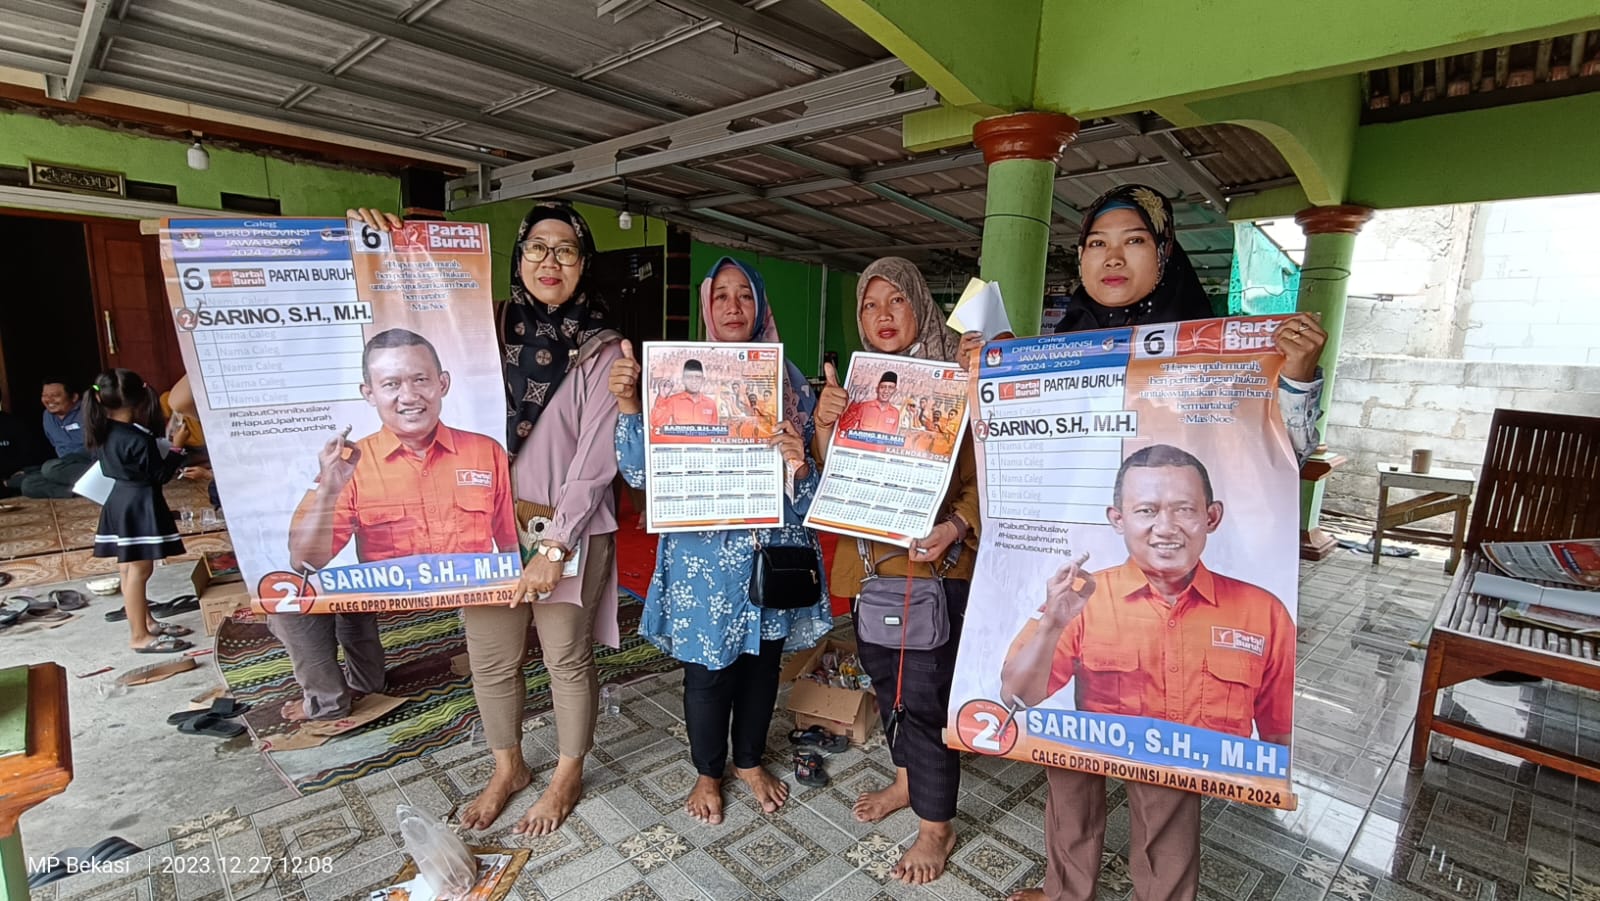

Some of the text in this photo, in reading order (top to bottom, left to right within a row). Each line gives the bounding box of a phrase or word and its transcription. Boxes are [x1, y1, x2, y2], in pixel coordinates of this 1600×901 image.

[243, 220, 278, 229] Caleg
[428, 224, 480, 236] Partai
[213, 229, 311, 237] DPRD PROVINSI
[361, 224, 382, 249] 6
[225, 238, 303, 247] JAWA BARAT
[430, 236, 481, 249] Buruh
[183, 267, 205, 291] 6
[232, 270, 264, 278] Partai
[268, 266, 355, 282] PARTAI BURUH
[233, 277, 266, 285] Buruh
[198, 303, 372, 326] SARINO, S.H., M.H.
[182, 314, 194, 328] 2
[216, 331, 247, 340] Nama
[250, 328, 278, 339] Caleg
[1038, 336, 1066, 344] Caleg
[1041, 340, 1093, 351] PROVINSI
[1143, 329, 1166, 355] 6
[219, 347, 250, 356] Nama
[253, 345, 281, 355] Caleg
[738, 352, 745, 361] 6
[1018, 350, 1085, 362] JAWA BARAT
[223, 363, 253, 372] Nama
[255, 361, 284, 371] Caleg
[1020, 363, 1046, 371] 2024
[1053, 360, 1081, 368] 2029
[1199, 361, 1224, 373] upah
[934, 370, 941, 378] 6
[1234, 374, 1267, 384] hukum
[226, 379, 257, 389] Nama
[259, 376, 287, 387] Caleg
[1015, 381, 1040, 390] Partai
[1044, 373, 1125, 393] PARTAI BURUH
[230, 395, 260, 404] Nama
[262, 392, 289, 403] Caleg
[980, 382, 995, 404] 6
[1015, 388, 1040, 397] Buruh
[1219, 388, 1245, 398] kaum
[988, 414, 1136, 437] SARINO, S.H., M.H.
[1000, 442, 1022, 451] Nama
[1022, 440, 1044, 451] Caleg
[886, 447, 949, 462] KALENDAR 2024
[1000, 458, 1023, 467] Nama
[1023, 457, 1044, 467] Caleg
[1001, 473, 1023, 482] Nama
[1023, 473, 1043, 484] Caleg
[1000, 489, 1022, 499] Nama
[1023, 490, 1041, 502] Caleg
[1000, 506, 1022, 516] Nama
[1022, 507, 1041, 518] Caleg
[323, 556, 521, 591] SARINO, S.H., M.H.
[271, 581, 301, 613] 2
[328, 600, 359, 612] CALEG
[361, 599, 387, 611] DPRD
[389, 597, 434, 610] PROVINSI
[436, 594, 462, 606] JAWA
[463, 591, 494, 604] BARAT
[971, 711, 1000, 751] 2
[1028, 710, 1287, 777] SARINO, S.H., M.H.
[1032, 749, 1281, 806] CALEG DPRD PROVINSI JAWA BARAT 2024
